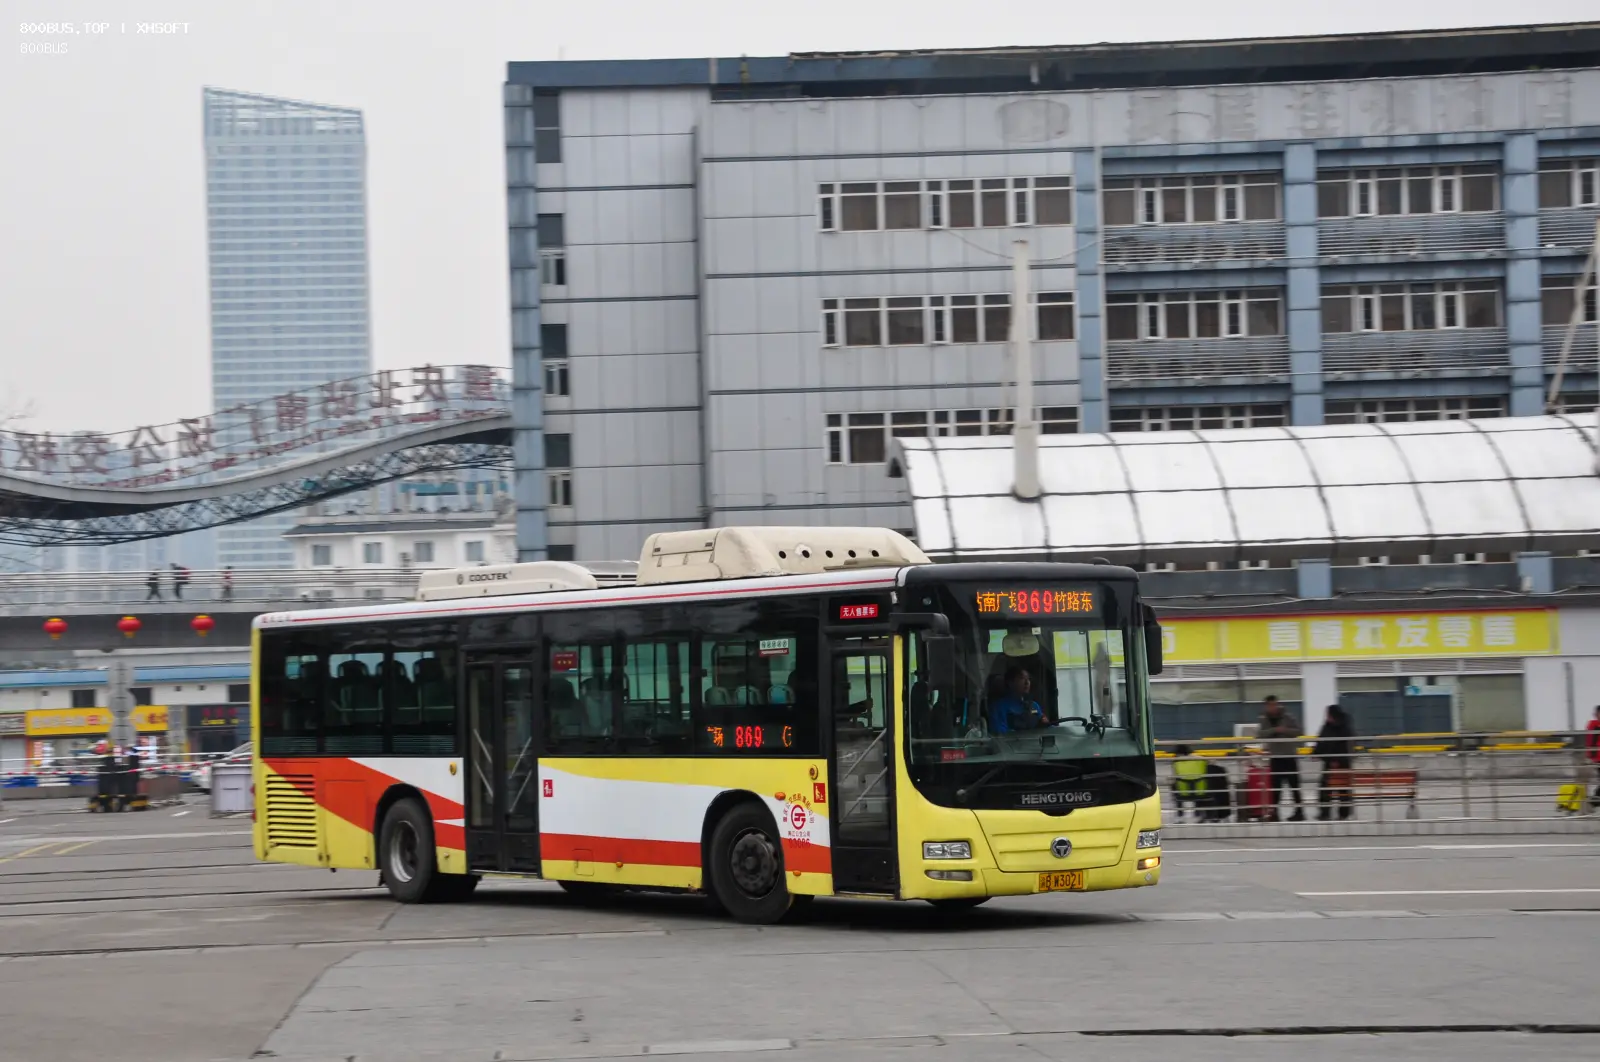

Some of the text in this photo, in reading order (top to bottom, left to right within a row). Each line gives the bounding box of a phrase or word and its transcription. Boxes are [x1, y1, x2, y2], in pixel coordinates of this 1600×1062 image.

[468, 572, 508, 583] COOLTEK
[1017, 590, 1053, 614] 869
[735, 725, 763, 748] 869
[1021, 791, 1093, 805] HENGTONG
